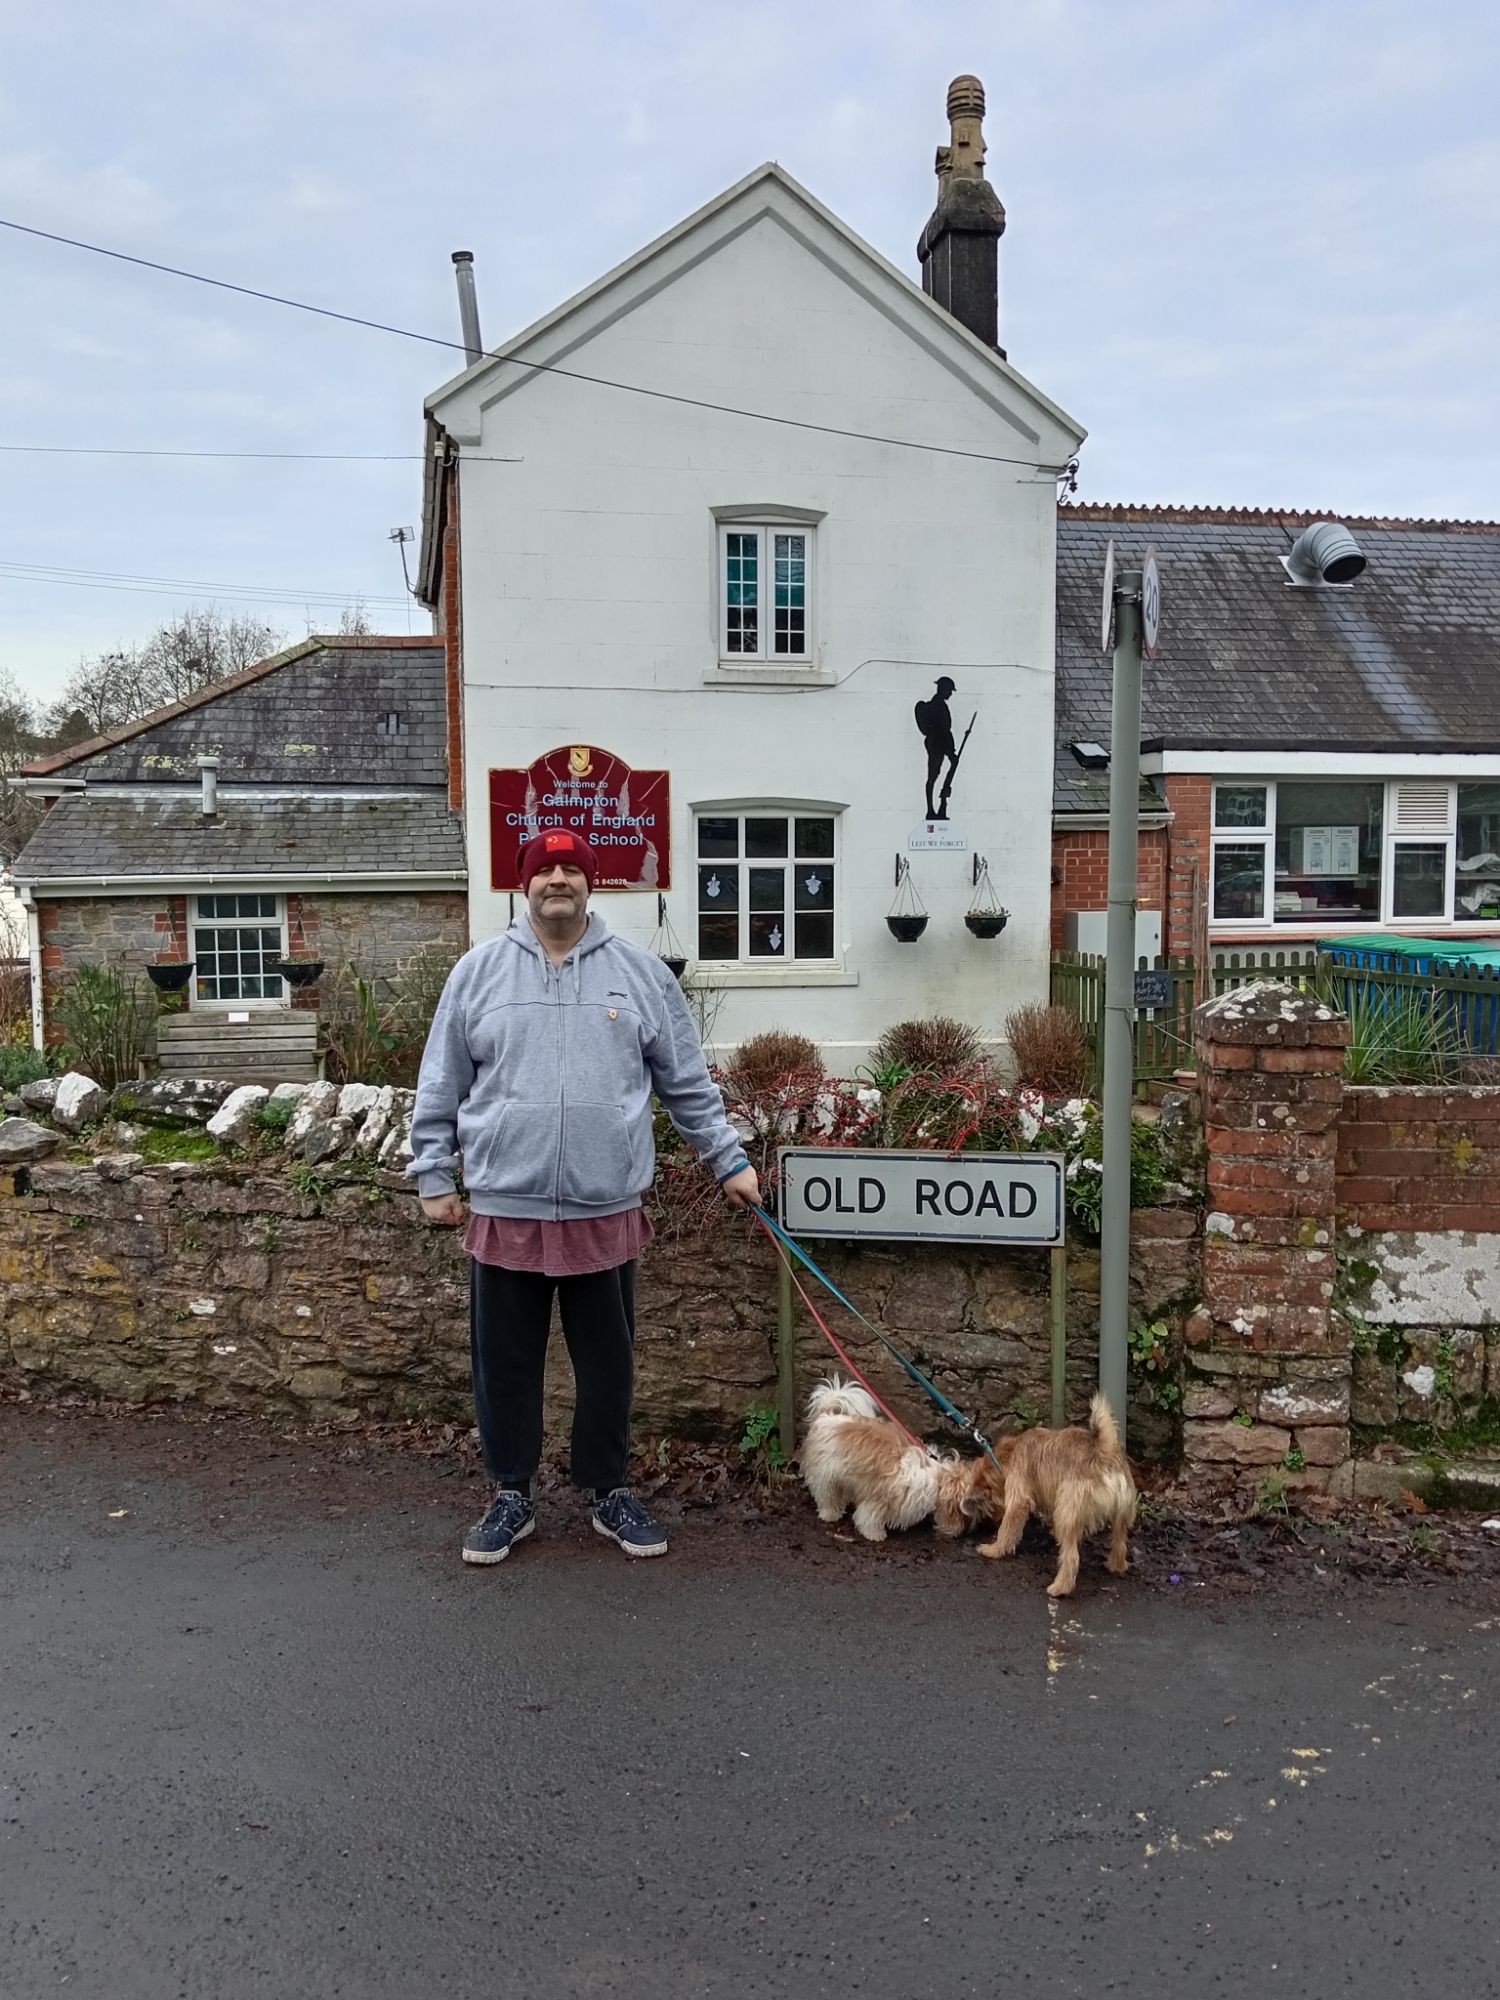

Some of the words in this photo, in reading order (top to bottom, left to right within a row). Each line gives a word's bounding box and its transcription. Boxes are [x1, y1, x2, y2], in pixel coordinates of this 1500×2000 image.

[1146, 576, 1158, 630] 20
[553, 780, 596, 789] Welcome
[599, 780, 609, 789] to
[542, 793, 619, 809] Galmpton
[506, 813, 563, 826] Church
[570, 813, 586, 826] of
[592, 813, 656, 829] England
[589, 832, 644, 846] School
[804, 1176, 885, 1213] OLD
[916, 1179, 1037, 1218] ROAD
